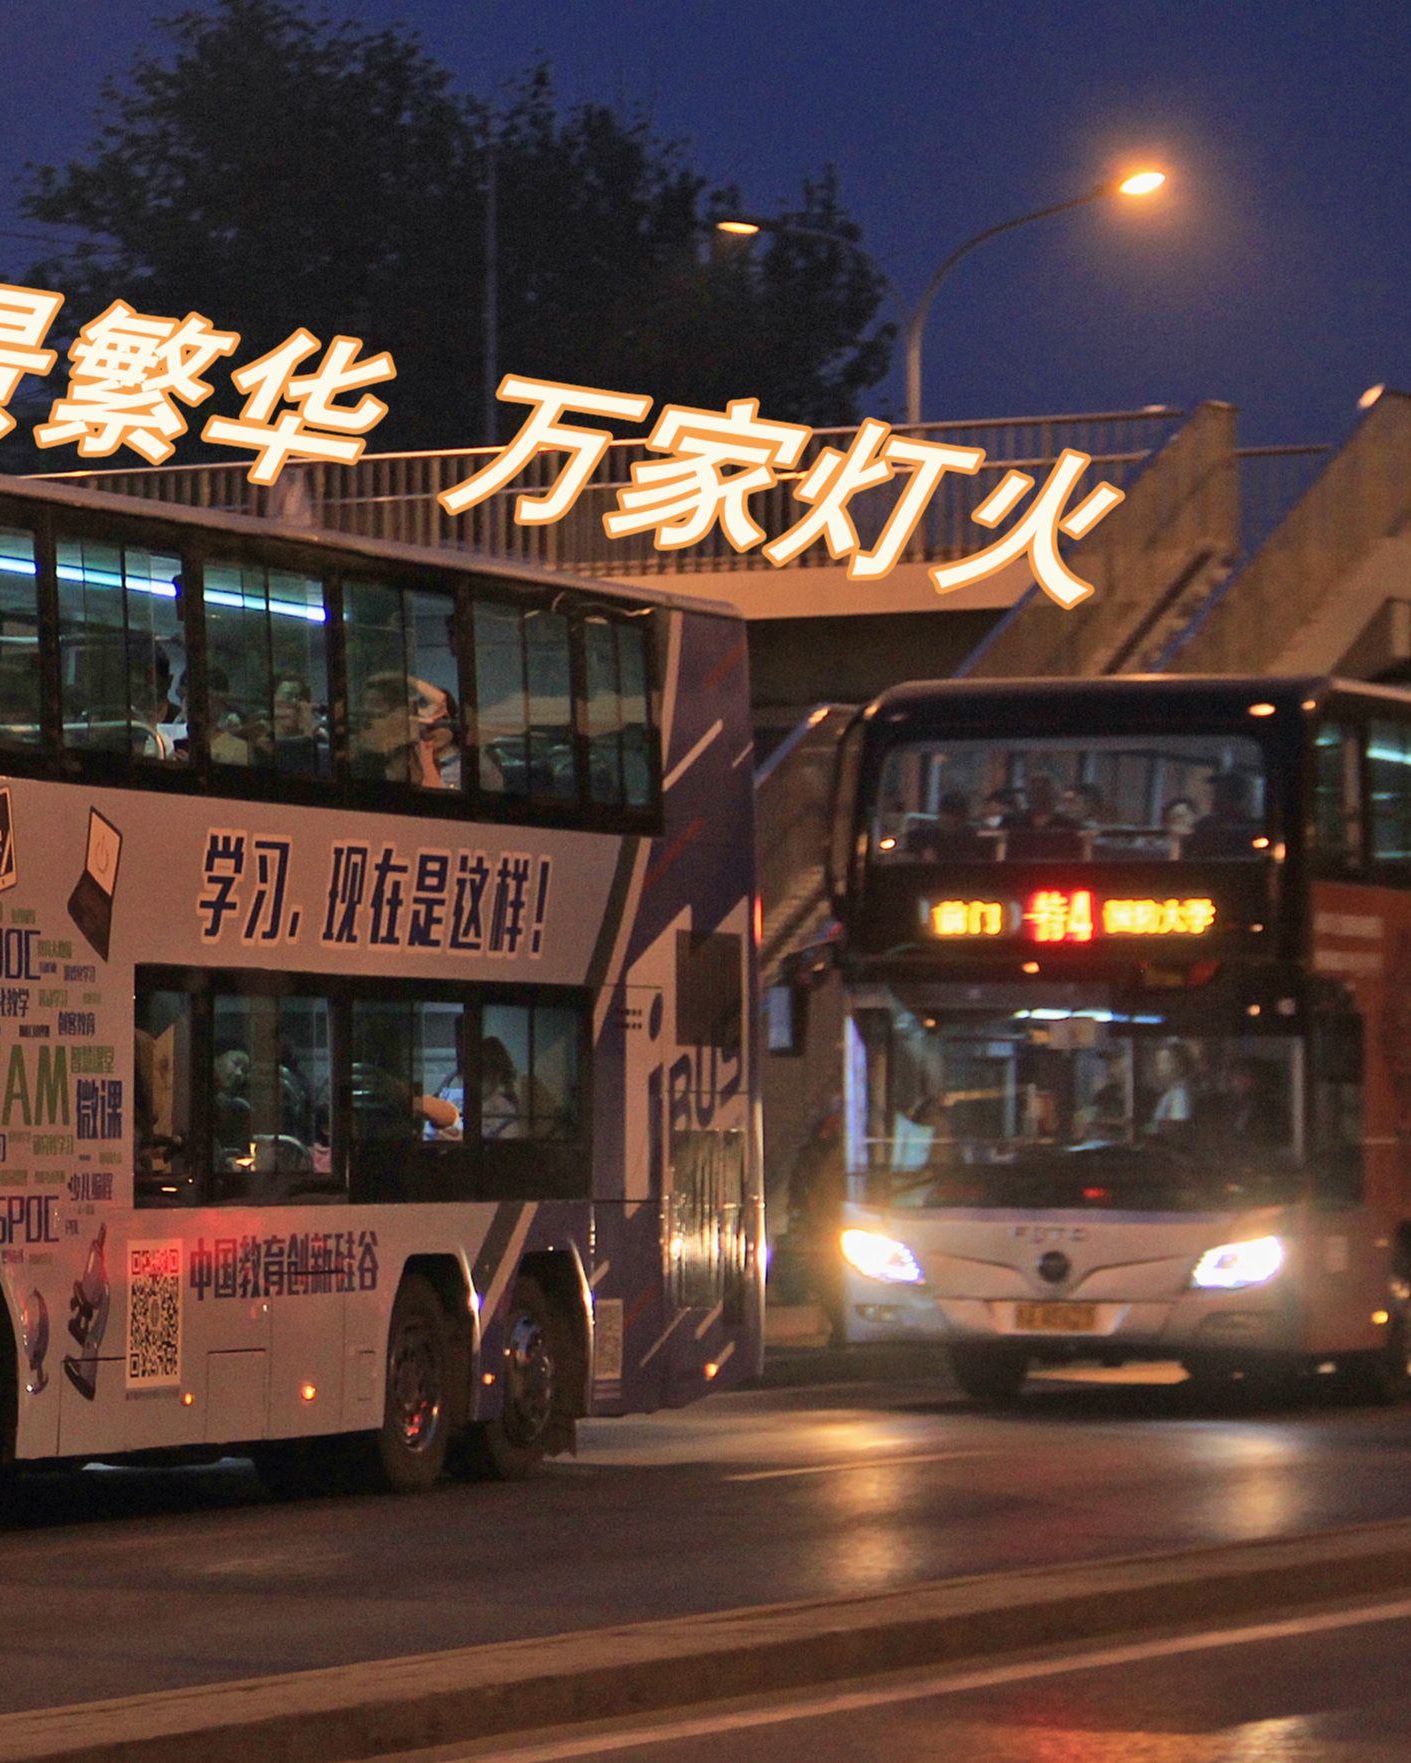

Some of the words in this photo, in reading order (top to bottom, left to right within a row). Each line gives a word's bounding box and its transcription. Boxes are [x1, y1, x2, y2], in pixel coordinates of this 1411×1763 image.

[76, 1078, 123, 1140] 微课
[189, 1230, 379, 1301] 中国教育创新硅谷
